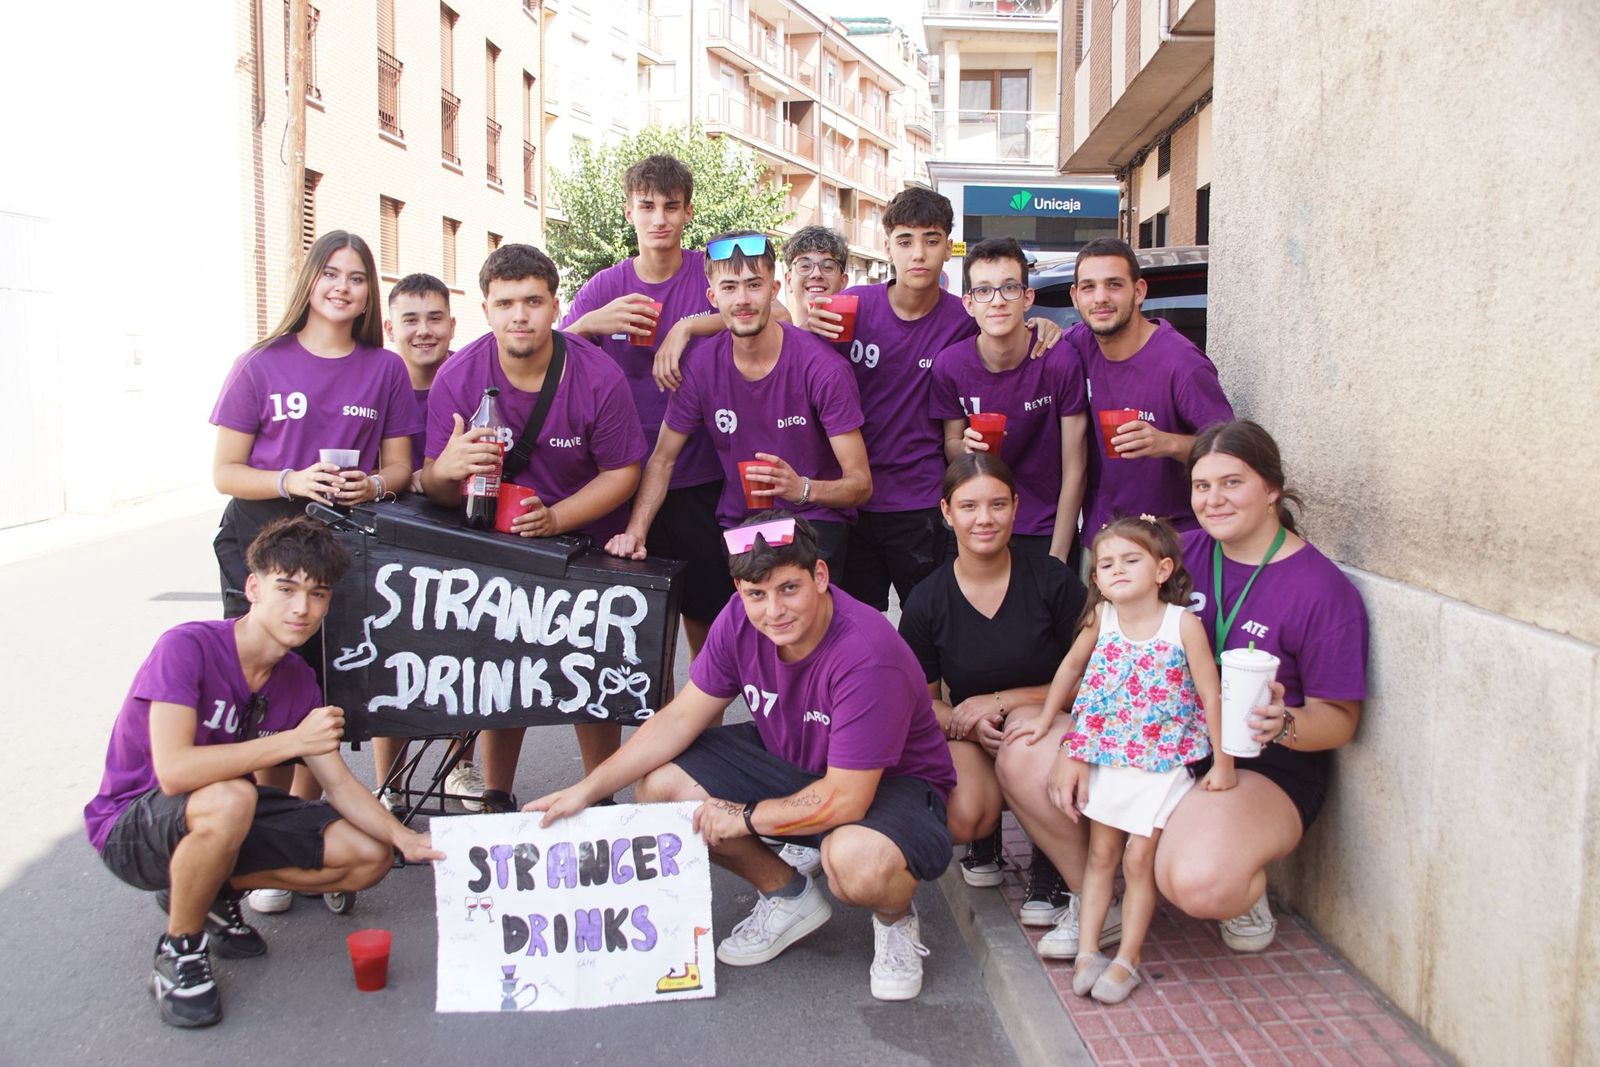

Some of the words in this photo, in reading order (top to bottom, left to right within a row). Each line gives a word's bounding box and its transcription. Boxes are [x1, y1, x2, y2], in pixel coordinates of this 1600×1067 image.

[1034, 198, 1081, 214] Unicaja
[850, 339, 880, 368] 09
[270, 391, 308, 422] 19
[714, 408, 738, 434] 69
[777, 415, 807, 429] DIEGO
[373, 562, 649, 665] STRANGER
[1241, 620, 1269, 638] ATE
[368, 652, 596, 716] DRINKS
[743, 684, 778, 718] 07
[468, 833, 682, 893] STRANGER
[502, 904, 658, 957] DRINKS
